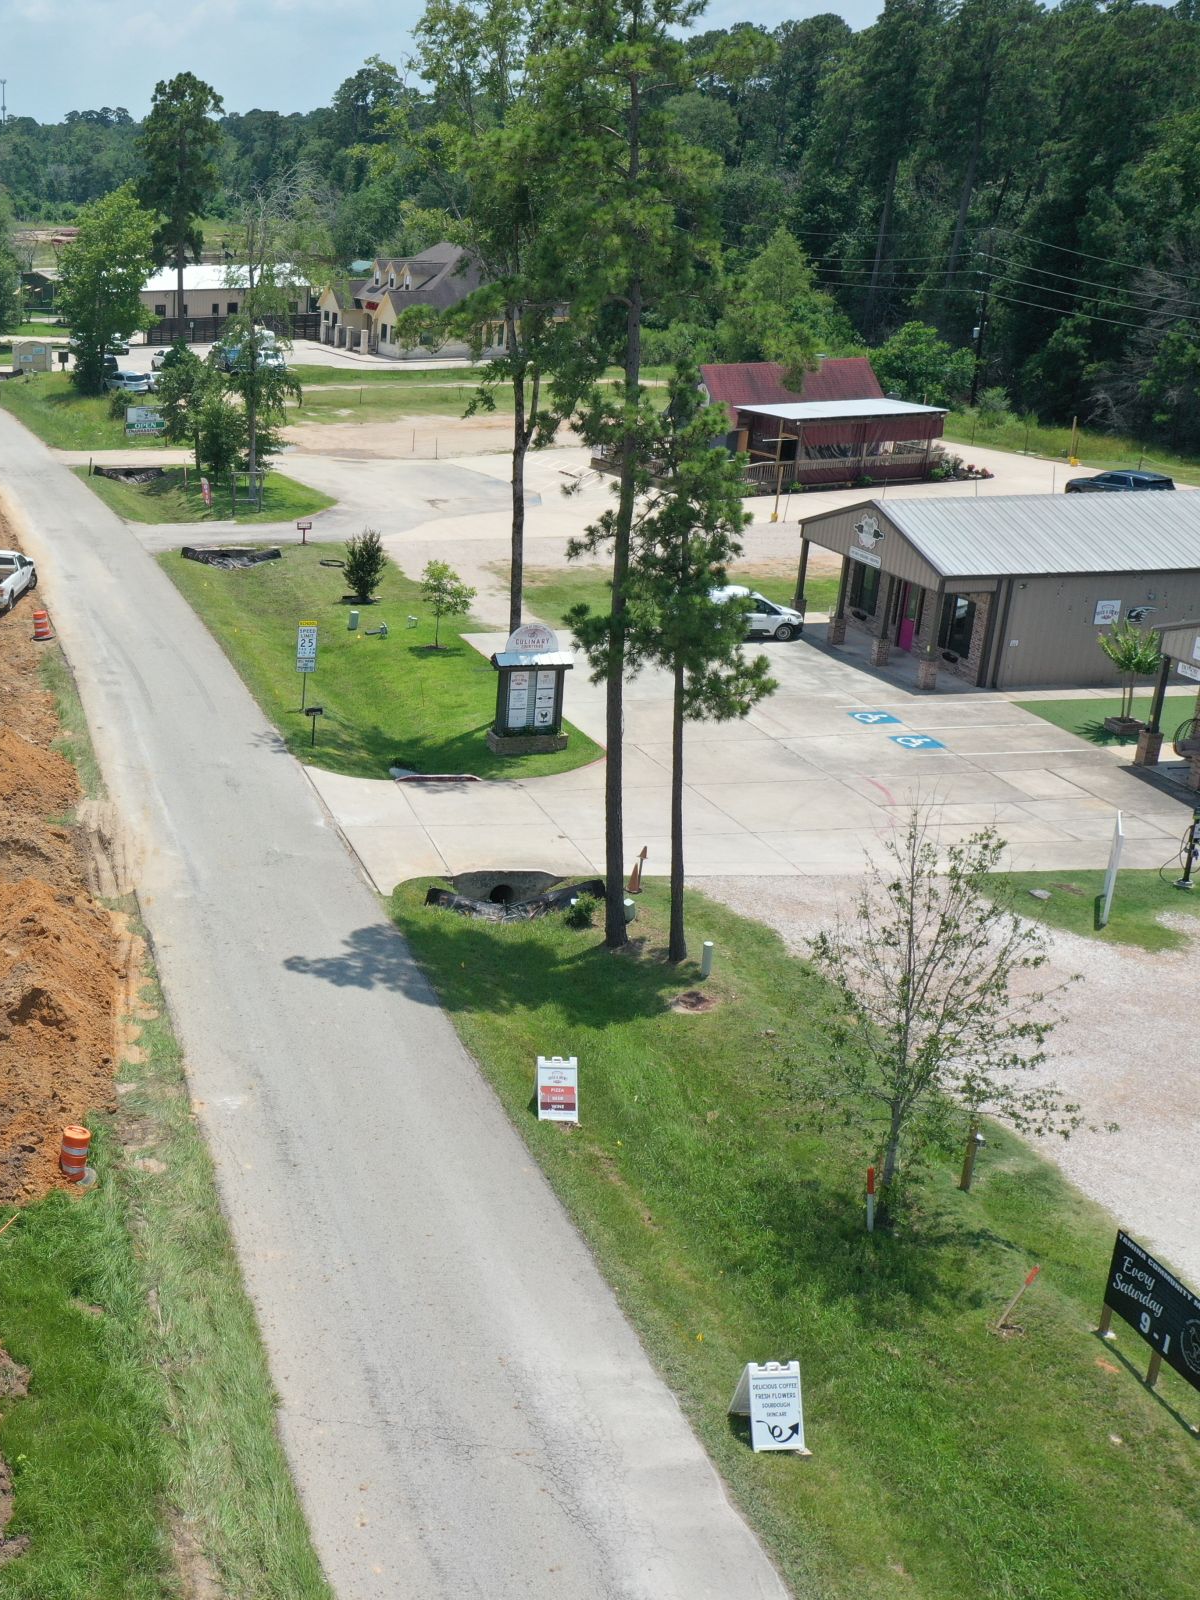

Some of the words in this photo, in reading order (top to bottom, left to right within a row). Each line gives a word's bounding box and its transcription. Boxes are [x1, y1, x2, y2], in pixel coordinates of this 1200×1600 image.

[300, 638, 314, 648] 25
[515, 638, 550, 646] CULINARY
[1119, 1232, 1147, 1261] TAMINA
[1147, 1257, 1192, 1301] COMMUNITY
[1122, 1255, 1156, 1291] Every
[1112, 1272, 1164, 1318] Saturday
[1139, 1311, 1151, 1334] 9
